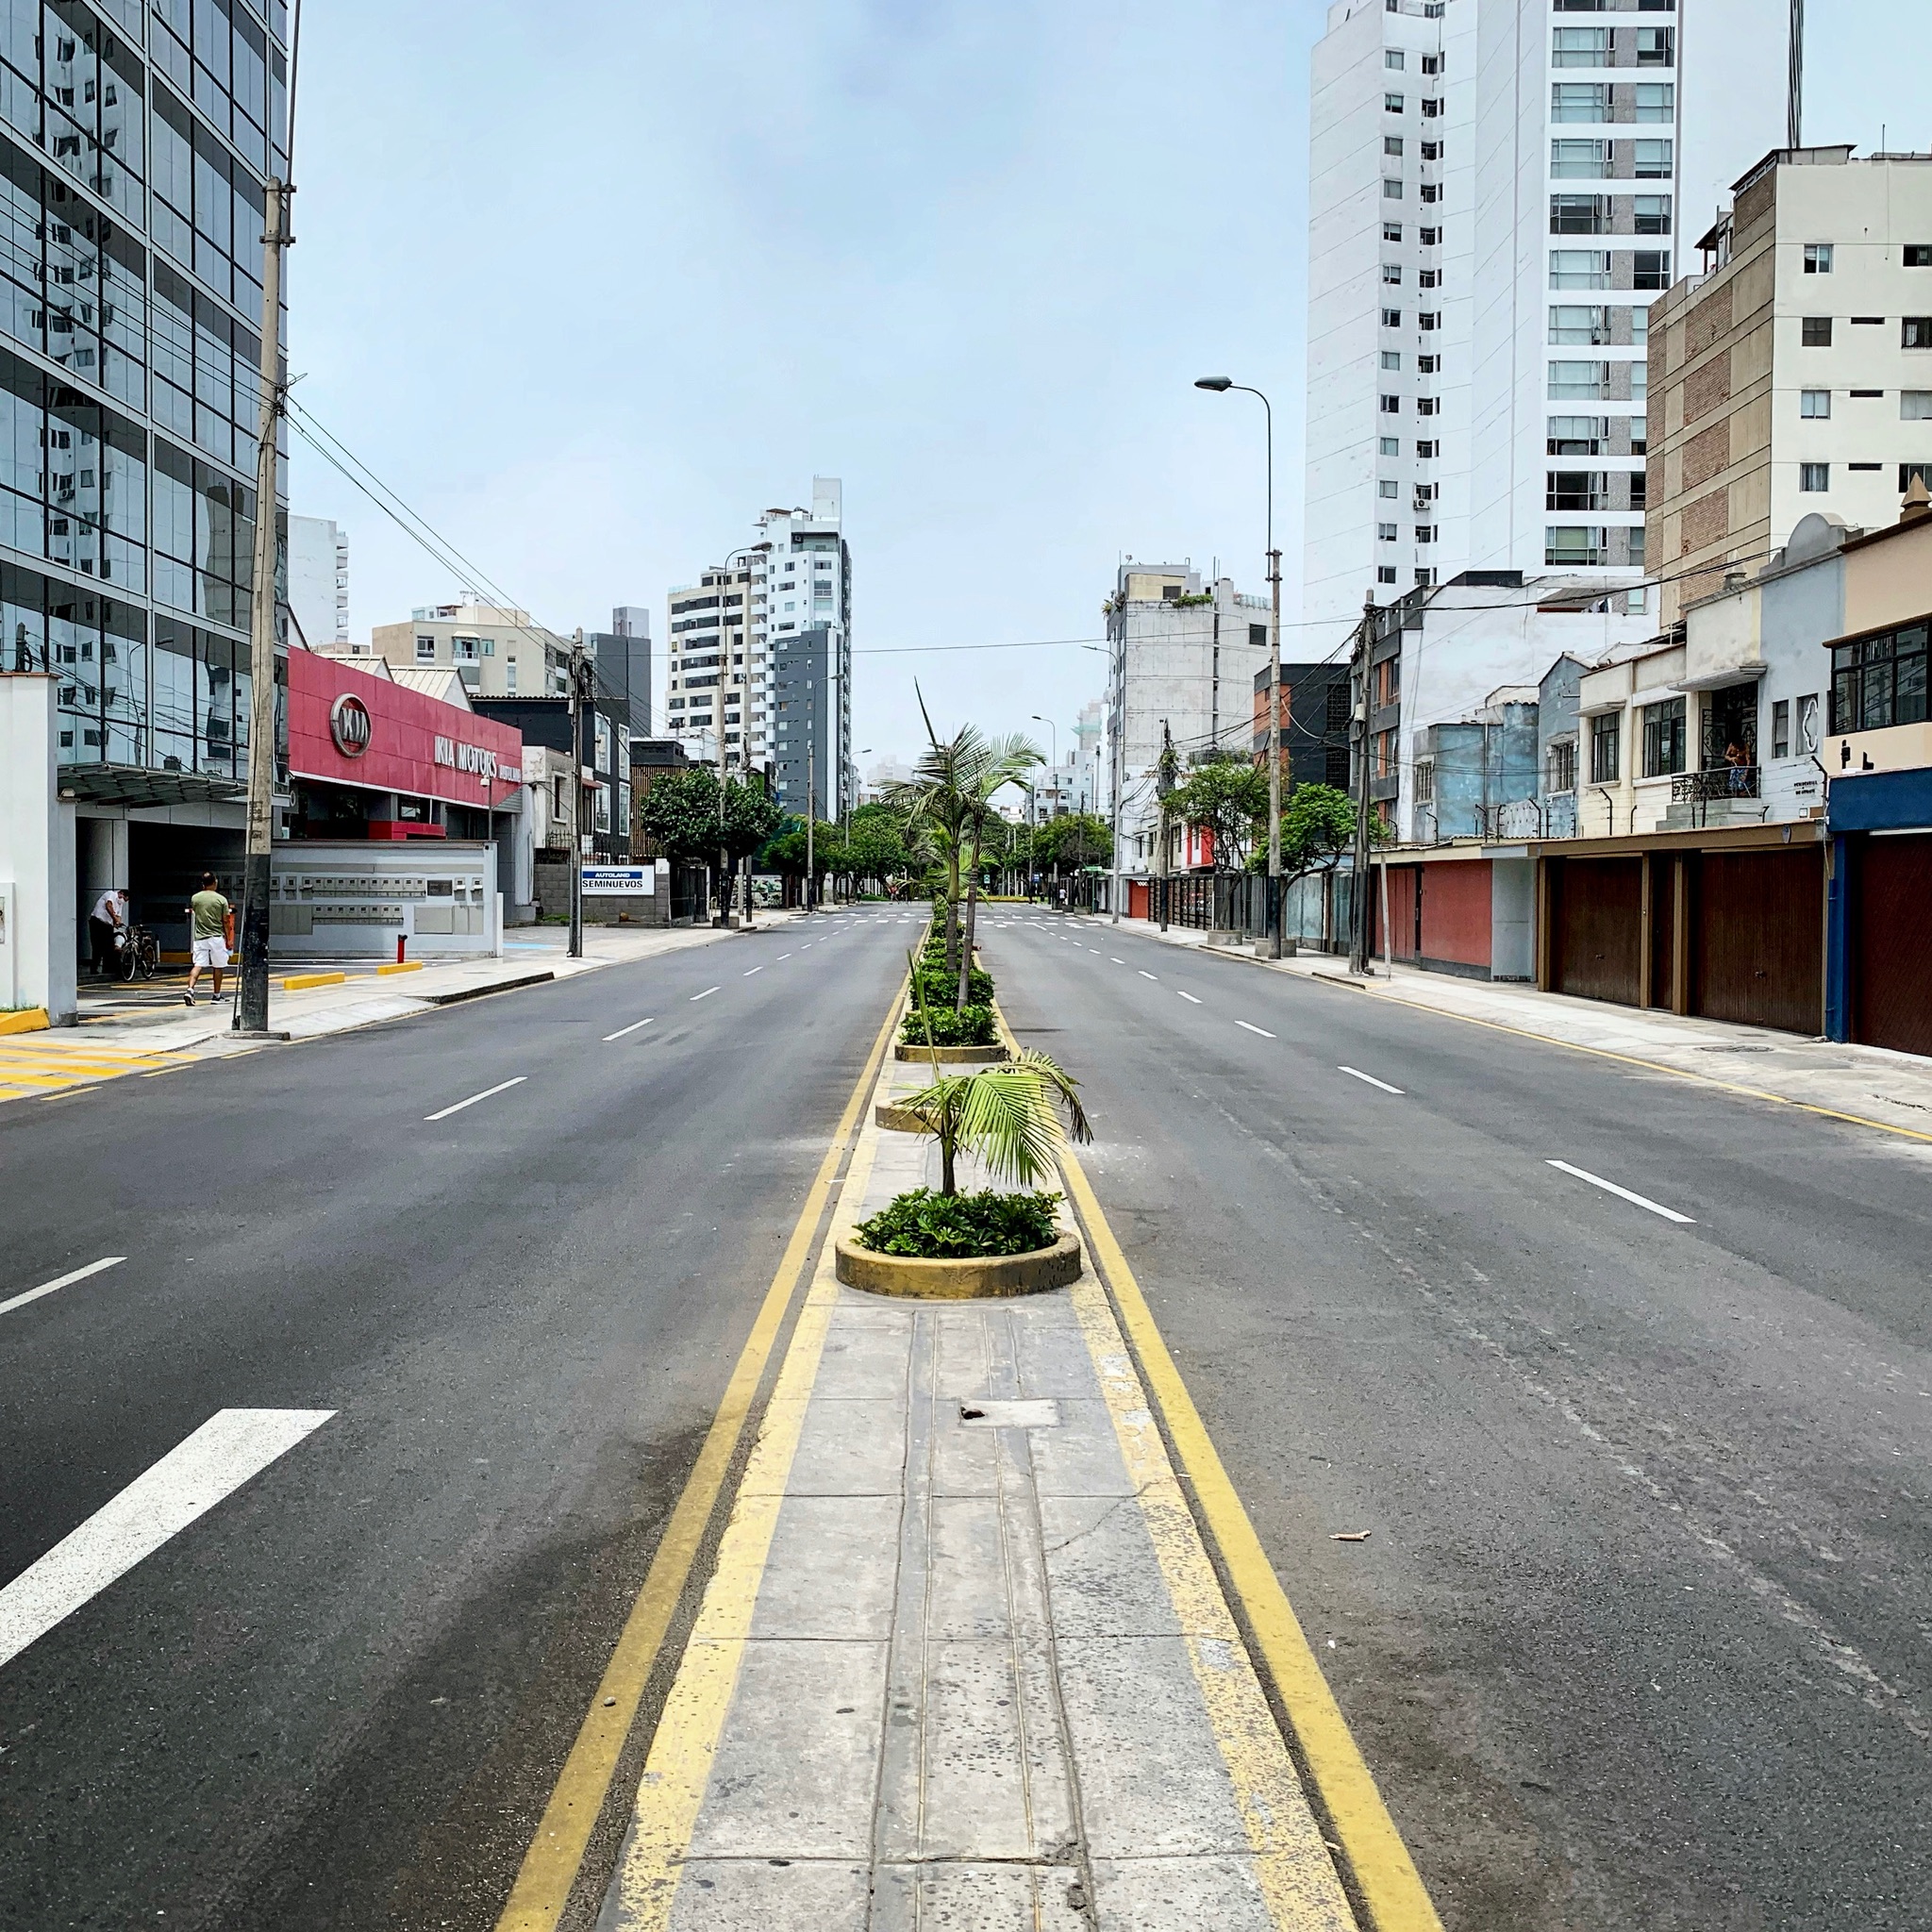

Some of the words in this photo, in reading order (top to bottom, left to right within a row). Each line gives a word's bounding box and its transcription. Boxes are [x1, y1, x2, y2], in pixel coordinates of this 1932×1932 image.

[340, 707, 368, 743] KIA
[435, 736, 455, 768] KIA
[457, 742, 497, 778] MOTORS
